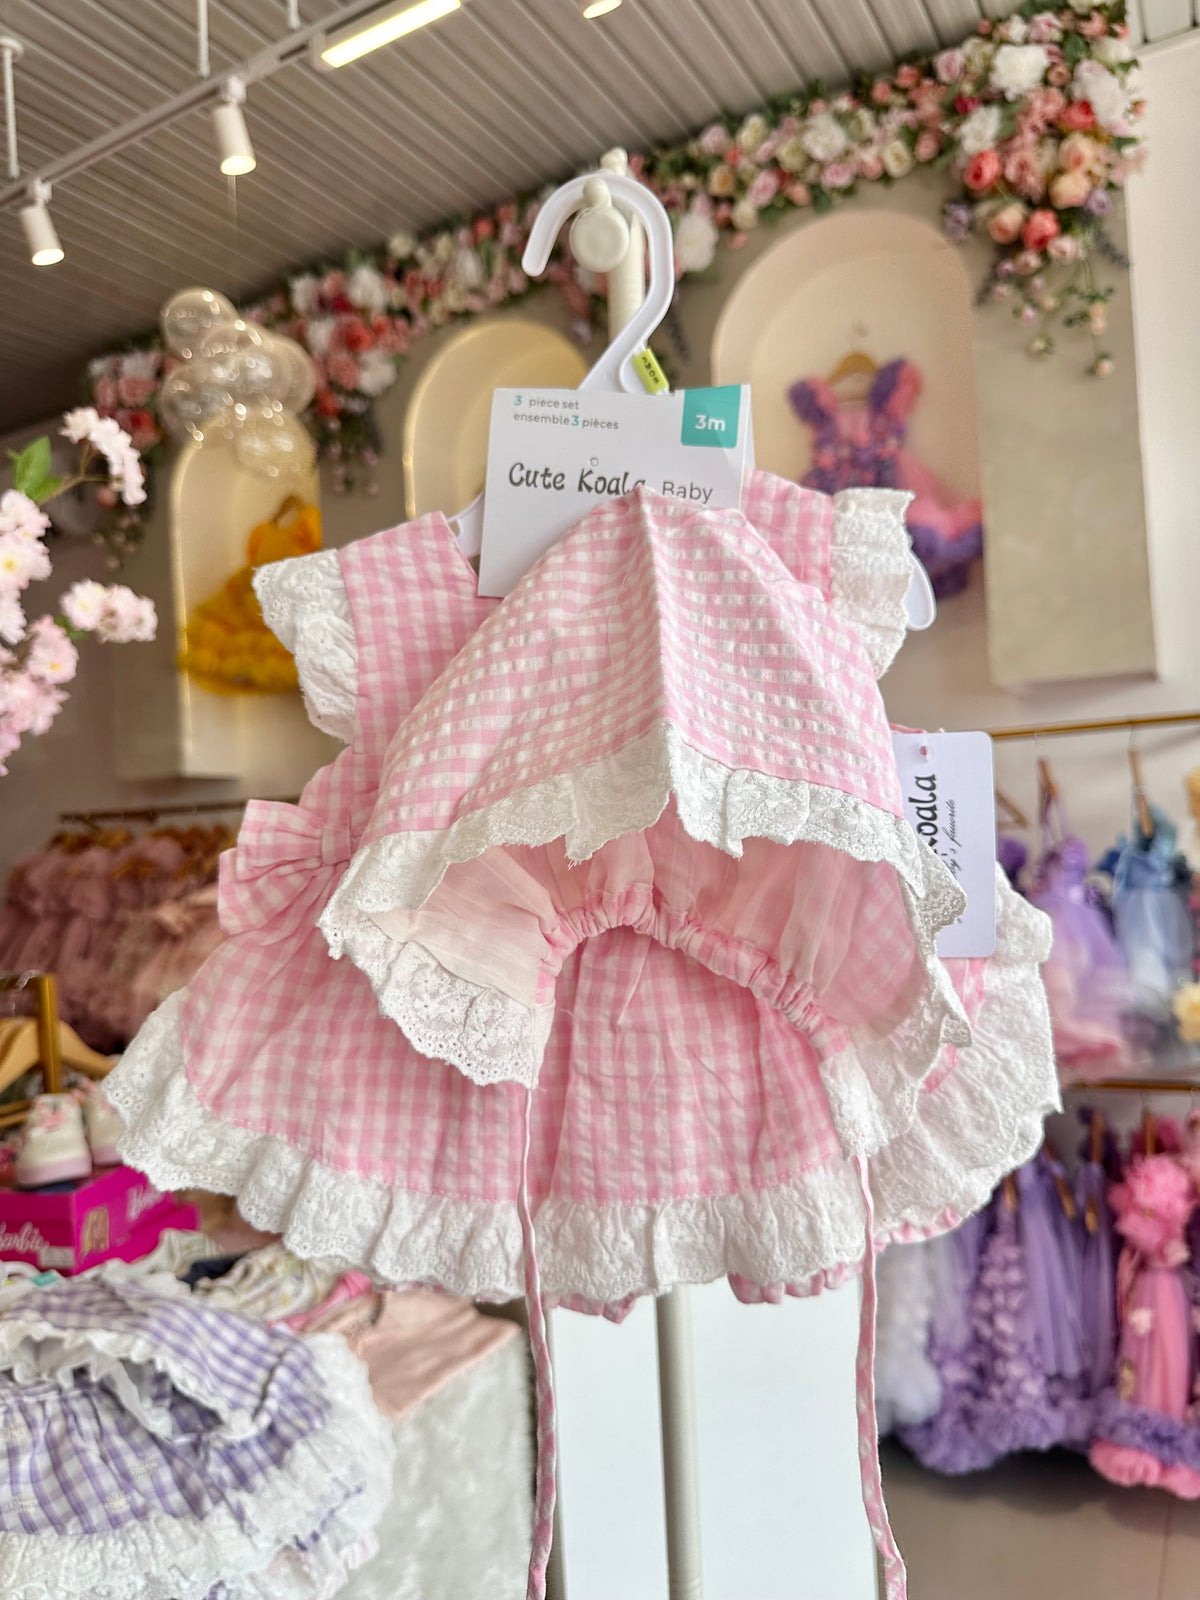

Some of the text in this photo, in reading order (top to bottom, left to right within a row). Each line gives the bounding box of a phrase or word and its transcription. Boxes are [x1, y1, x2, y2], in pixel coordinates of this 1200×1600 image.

[514, 395, 580, 410] 3 piece set
[513, 413, 619, 430] ensemble 3 pièces
[694, 414, 726, 432] 3m
[508, 462, 565, 491] Cute
[662, 481, 713, 505] Baby
